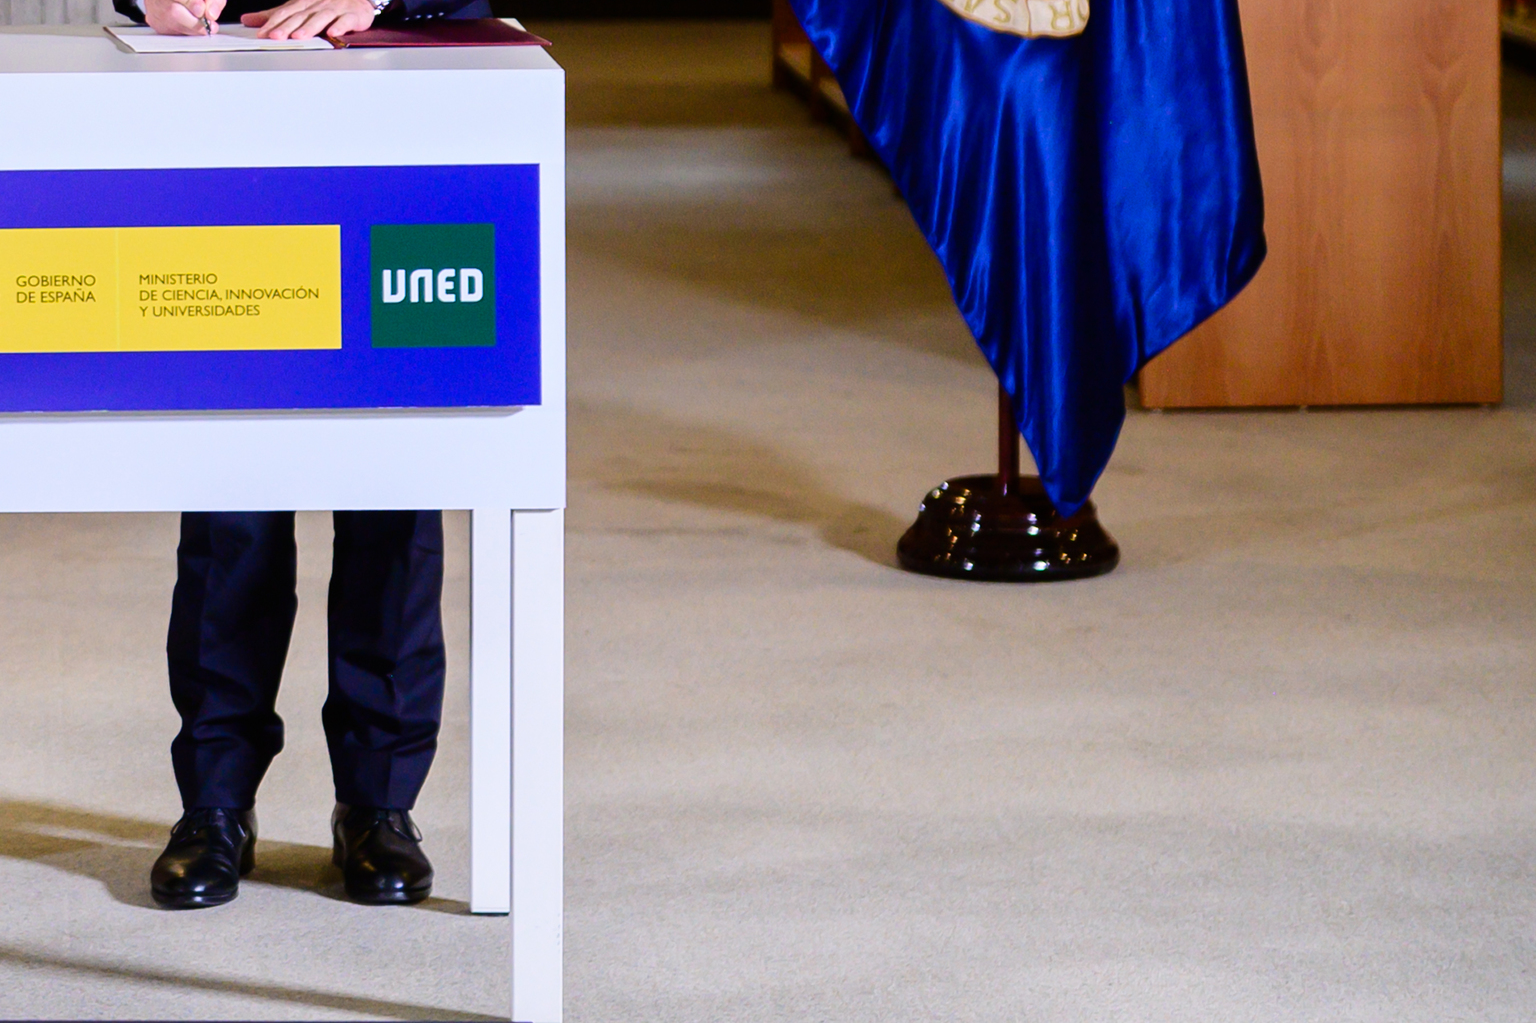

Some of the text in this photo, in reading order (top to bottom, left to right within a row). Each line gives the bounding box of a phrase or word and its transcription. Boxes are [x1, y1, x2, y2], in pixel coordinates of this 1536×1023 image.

[16, 274, 96, 287] GOBIERNO
[139, 273, 218, 285] MINISTERIO
[382, 268, 483, 303] UNED
[16, 288, 96, 304] DE ESPAÑA
[139, 287, 319, 302] DE CIENCIA, INNOVACIÓN
[139, 304, 260, 317] Y UNIVERSIDADES
